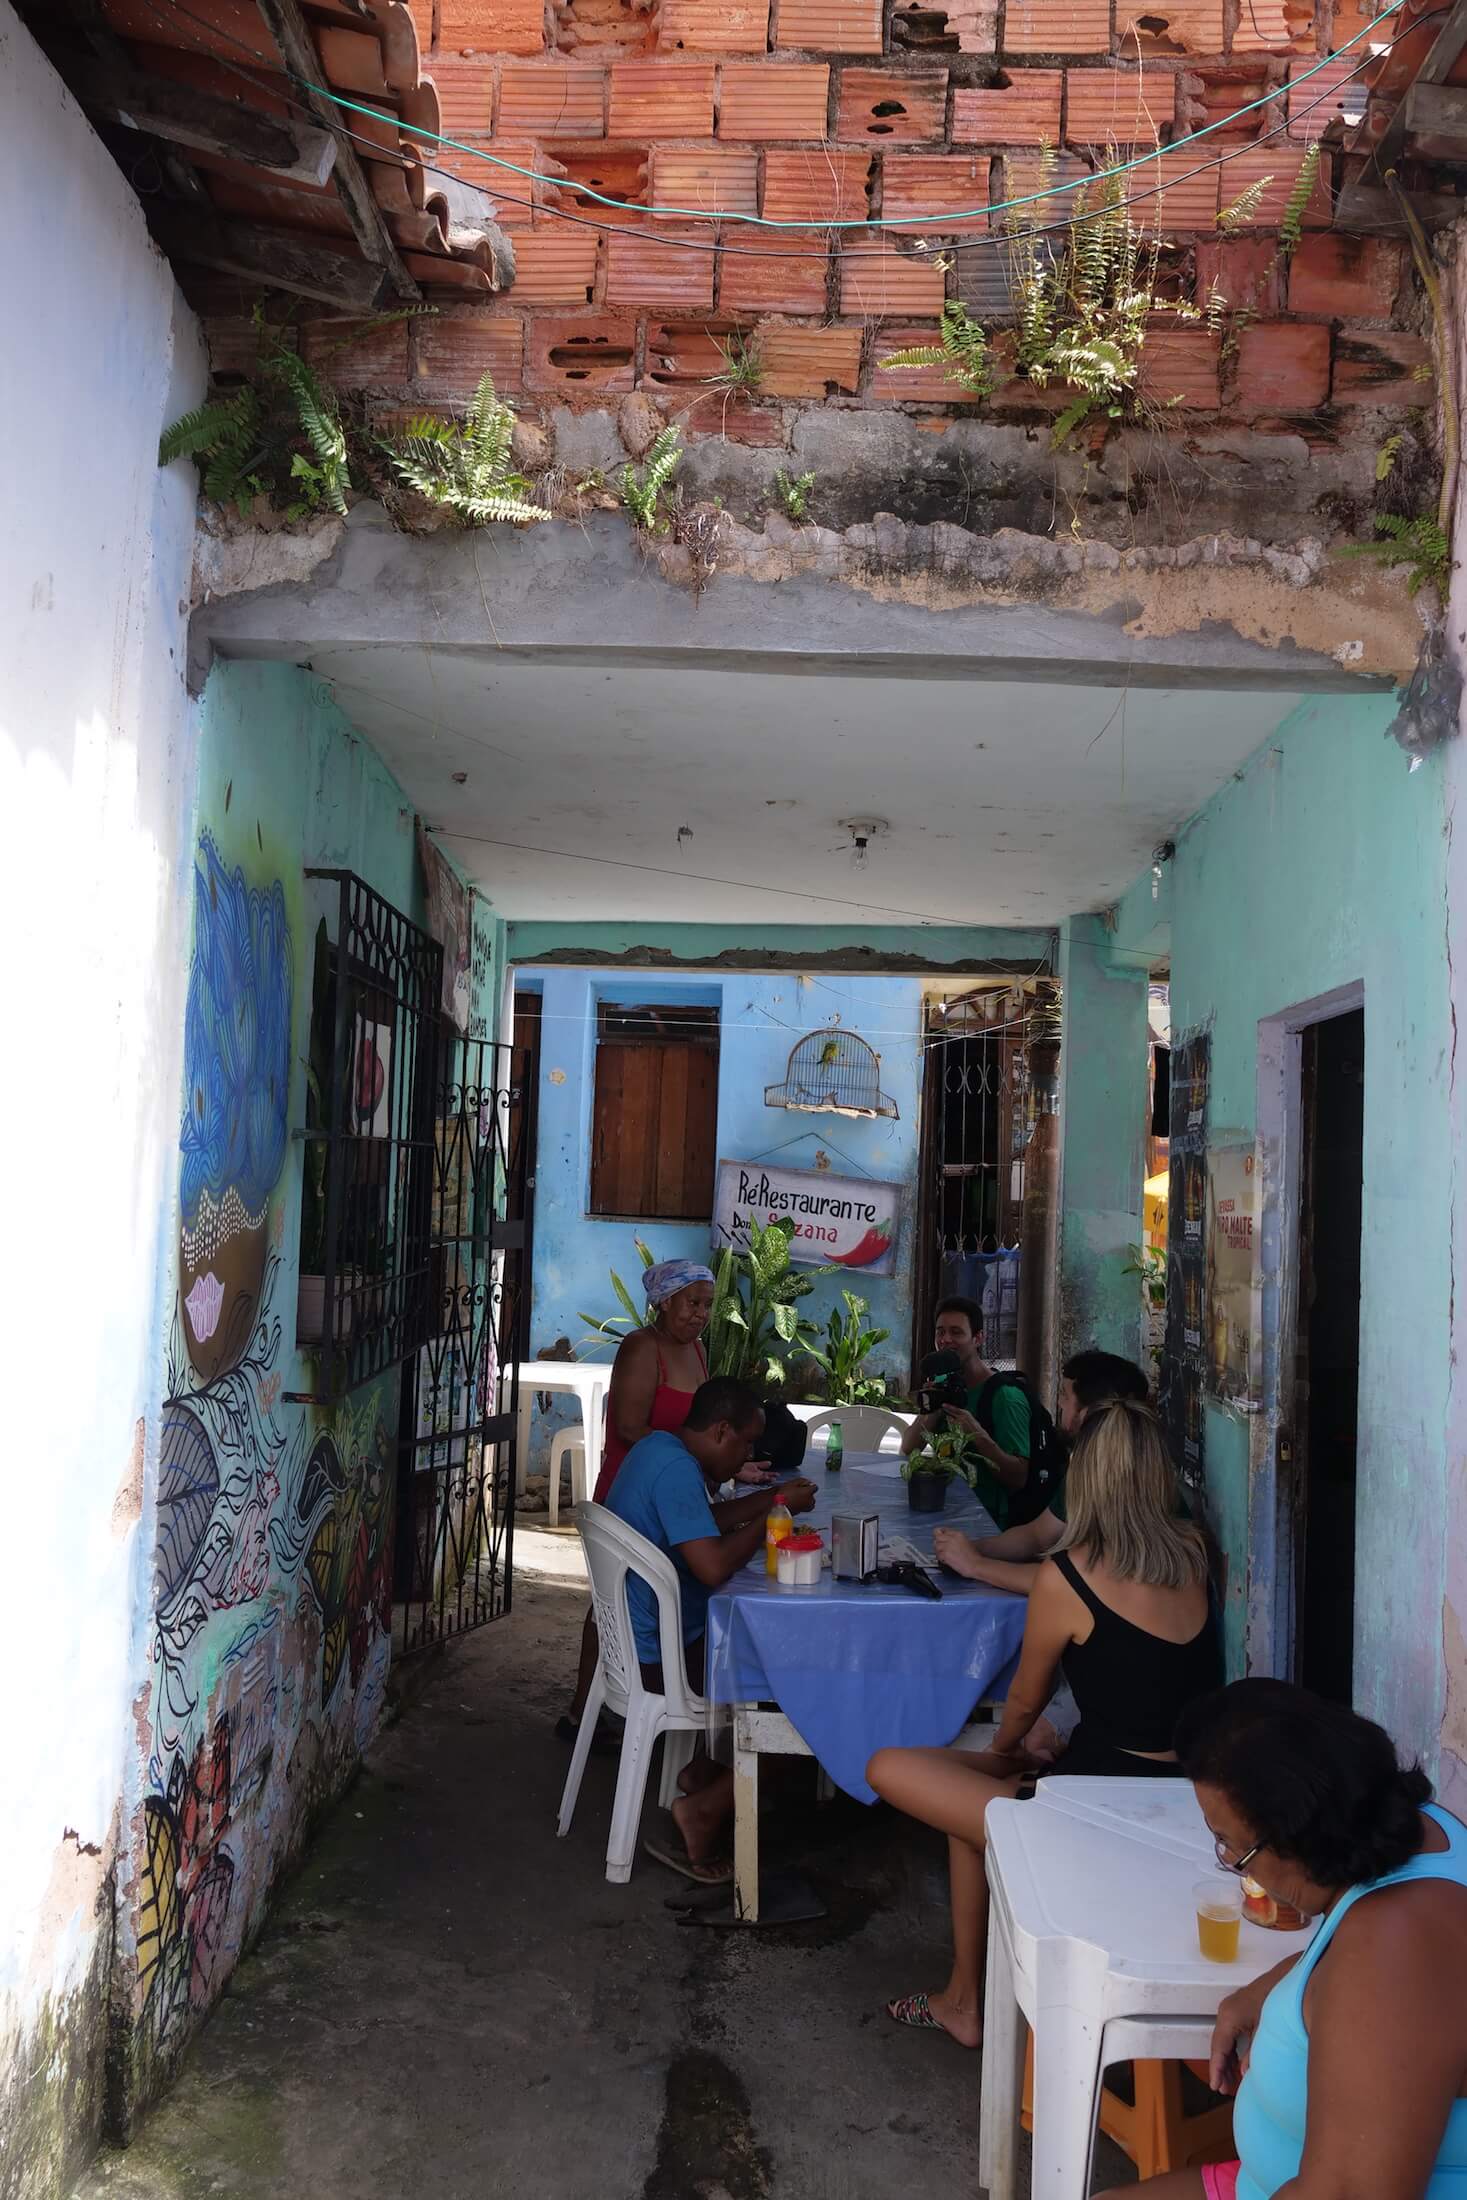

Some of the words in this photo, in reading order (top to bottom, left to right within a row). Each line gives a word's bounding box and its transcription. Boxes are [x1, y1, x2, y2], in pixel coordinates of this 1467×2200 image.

[733, 1211, 752, 1231] Don
[768, 1212, 838, 1243] Szana
[1230, 1216, 1252, 1235] MALTE
[1227, 1235, 1252, 1250] TROPICAL
